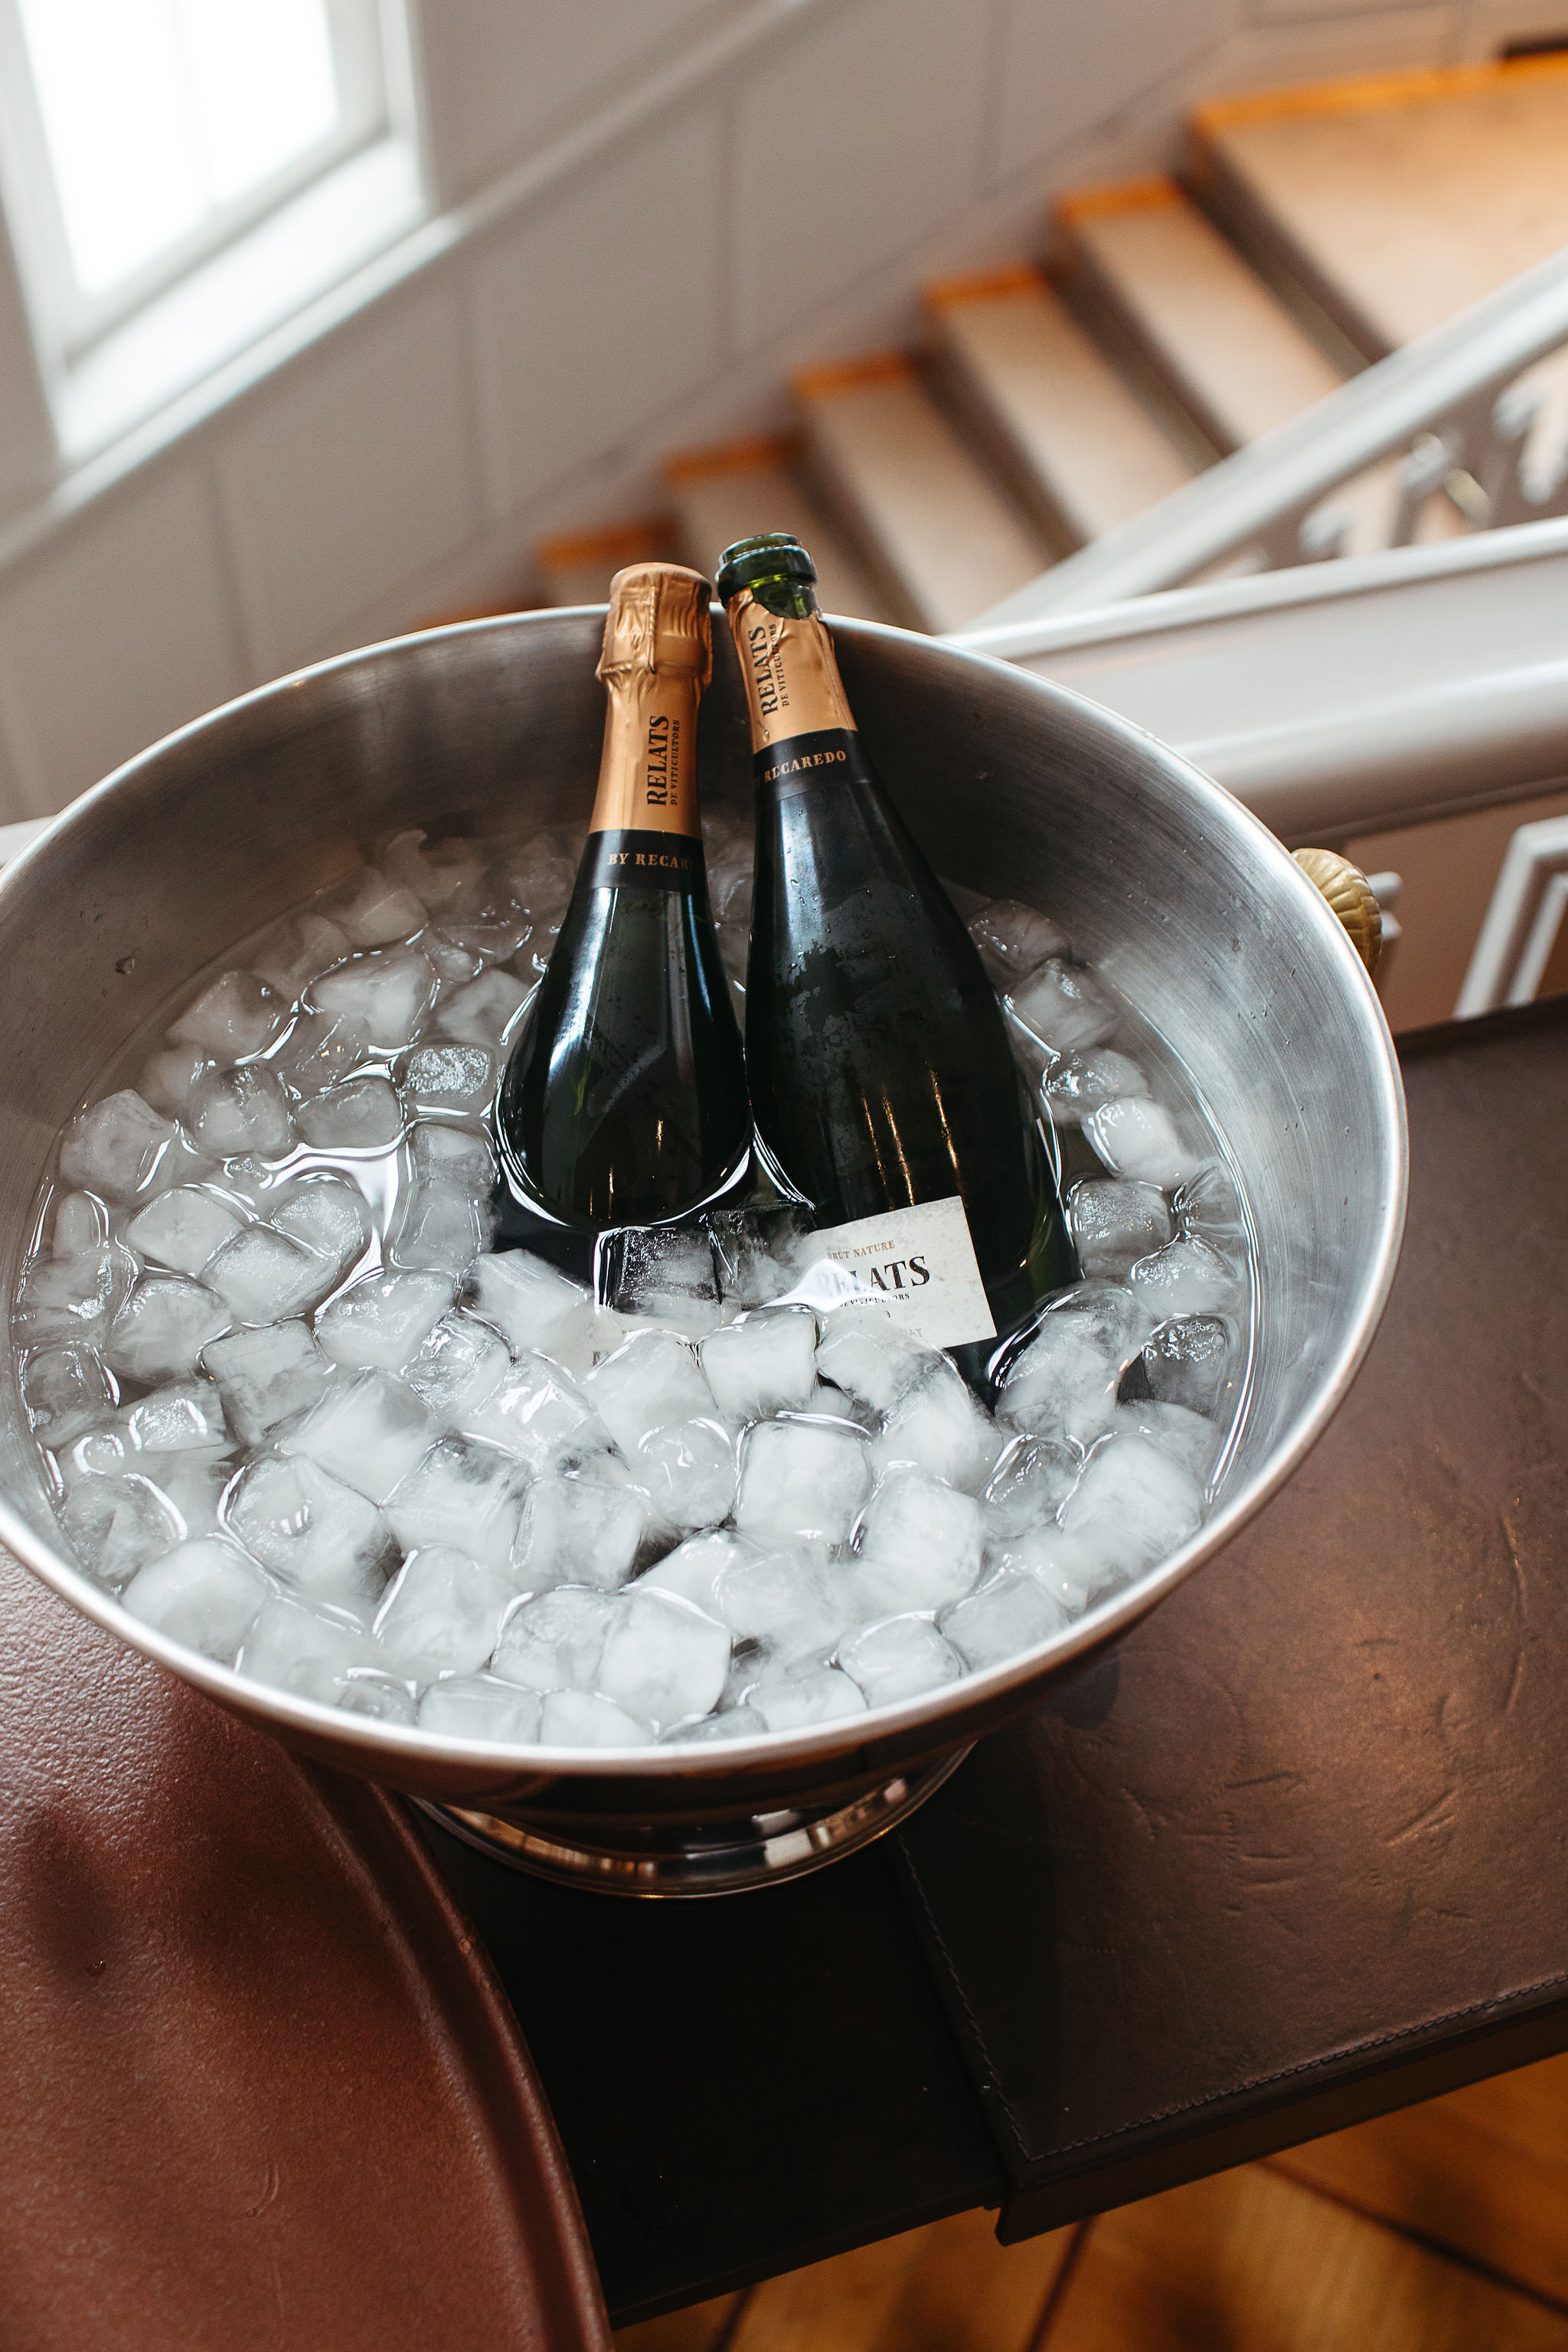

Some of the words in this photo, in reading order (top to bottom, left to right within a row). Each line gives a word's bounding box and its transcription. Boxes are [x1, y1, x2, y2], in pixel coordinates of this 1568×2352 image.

[748, 626, 778, 717] RELATS
[781, 693, 790, 707] DE
[647, 716, 668, 805] RELATS
[671, 719, 680, 789] VITICULTORS
[764, 750, 846, 782] RECAREDO
[670, 792, 678, 805] DE
[607, 852, 629, 865] BY
[827, 1251, 850, 1260] BRUT
[853, 1240, 895, 1258] NATURE
